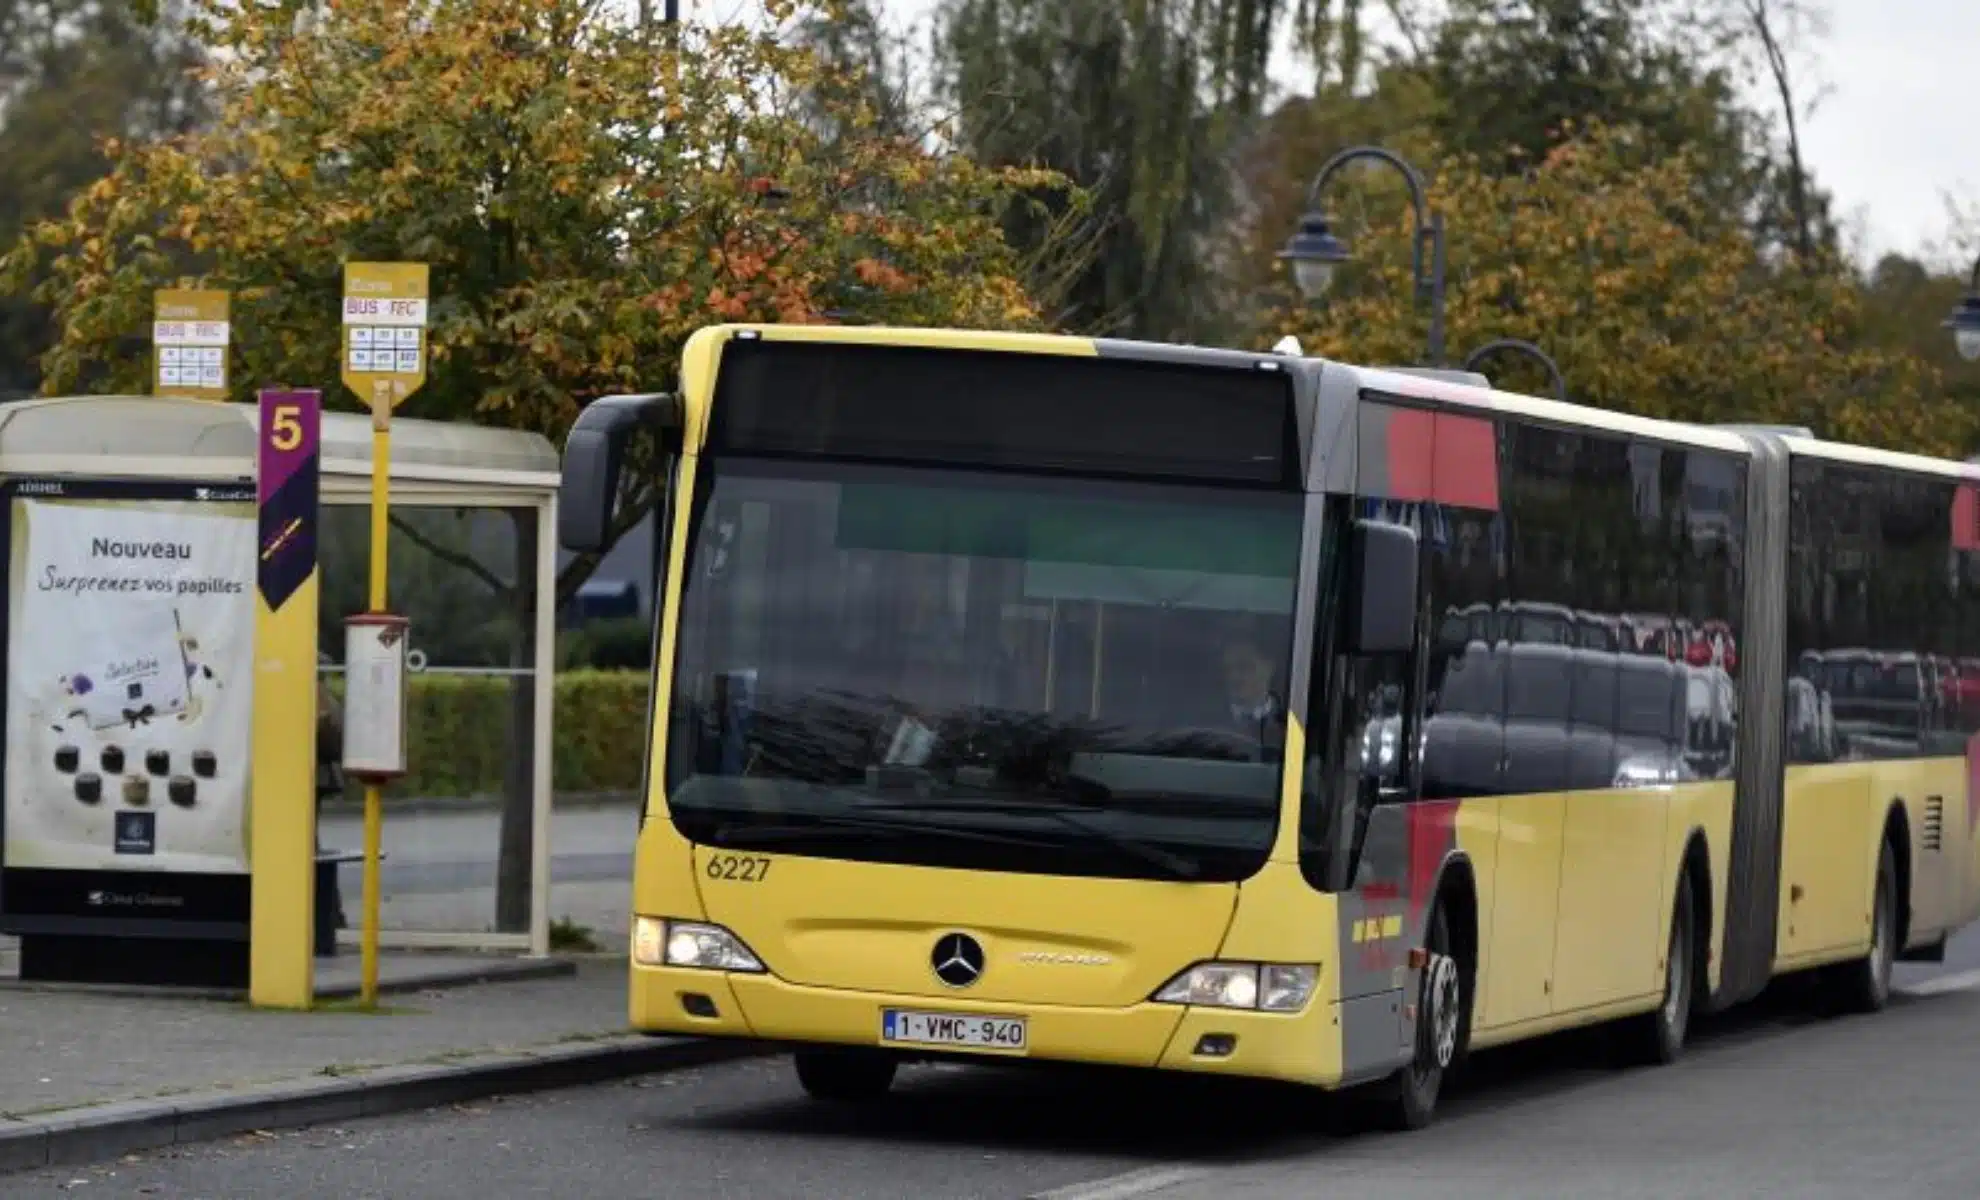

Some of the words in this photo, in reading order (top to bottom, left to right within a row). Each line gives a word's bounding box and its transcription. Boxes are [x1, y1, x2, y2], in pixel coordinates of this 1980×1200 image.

[271, 405, 302, 451] 5
[92, 537, 192, 559] Nouveau
[38, 565, 139, 595] Surprenez
[145, 579, 172, 593] vos
[178, 577, 242, 595] papilles
[707, 855, 772, 882] 6227
[899, 1015, 1023, 1045] 1-VMC-940
